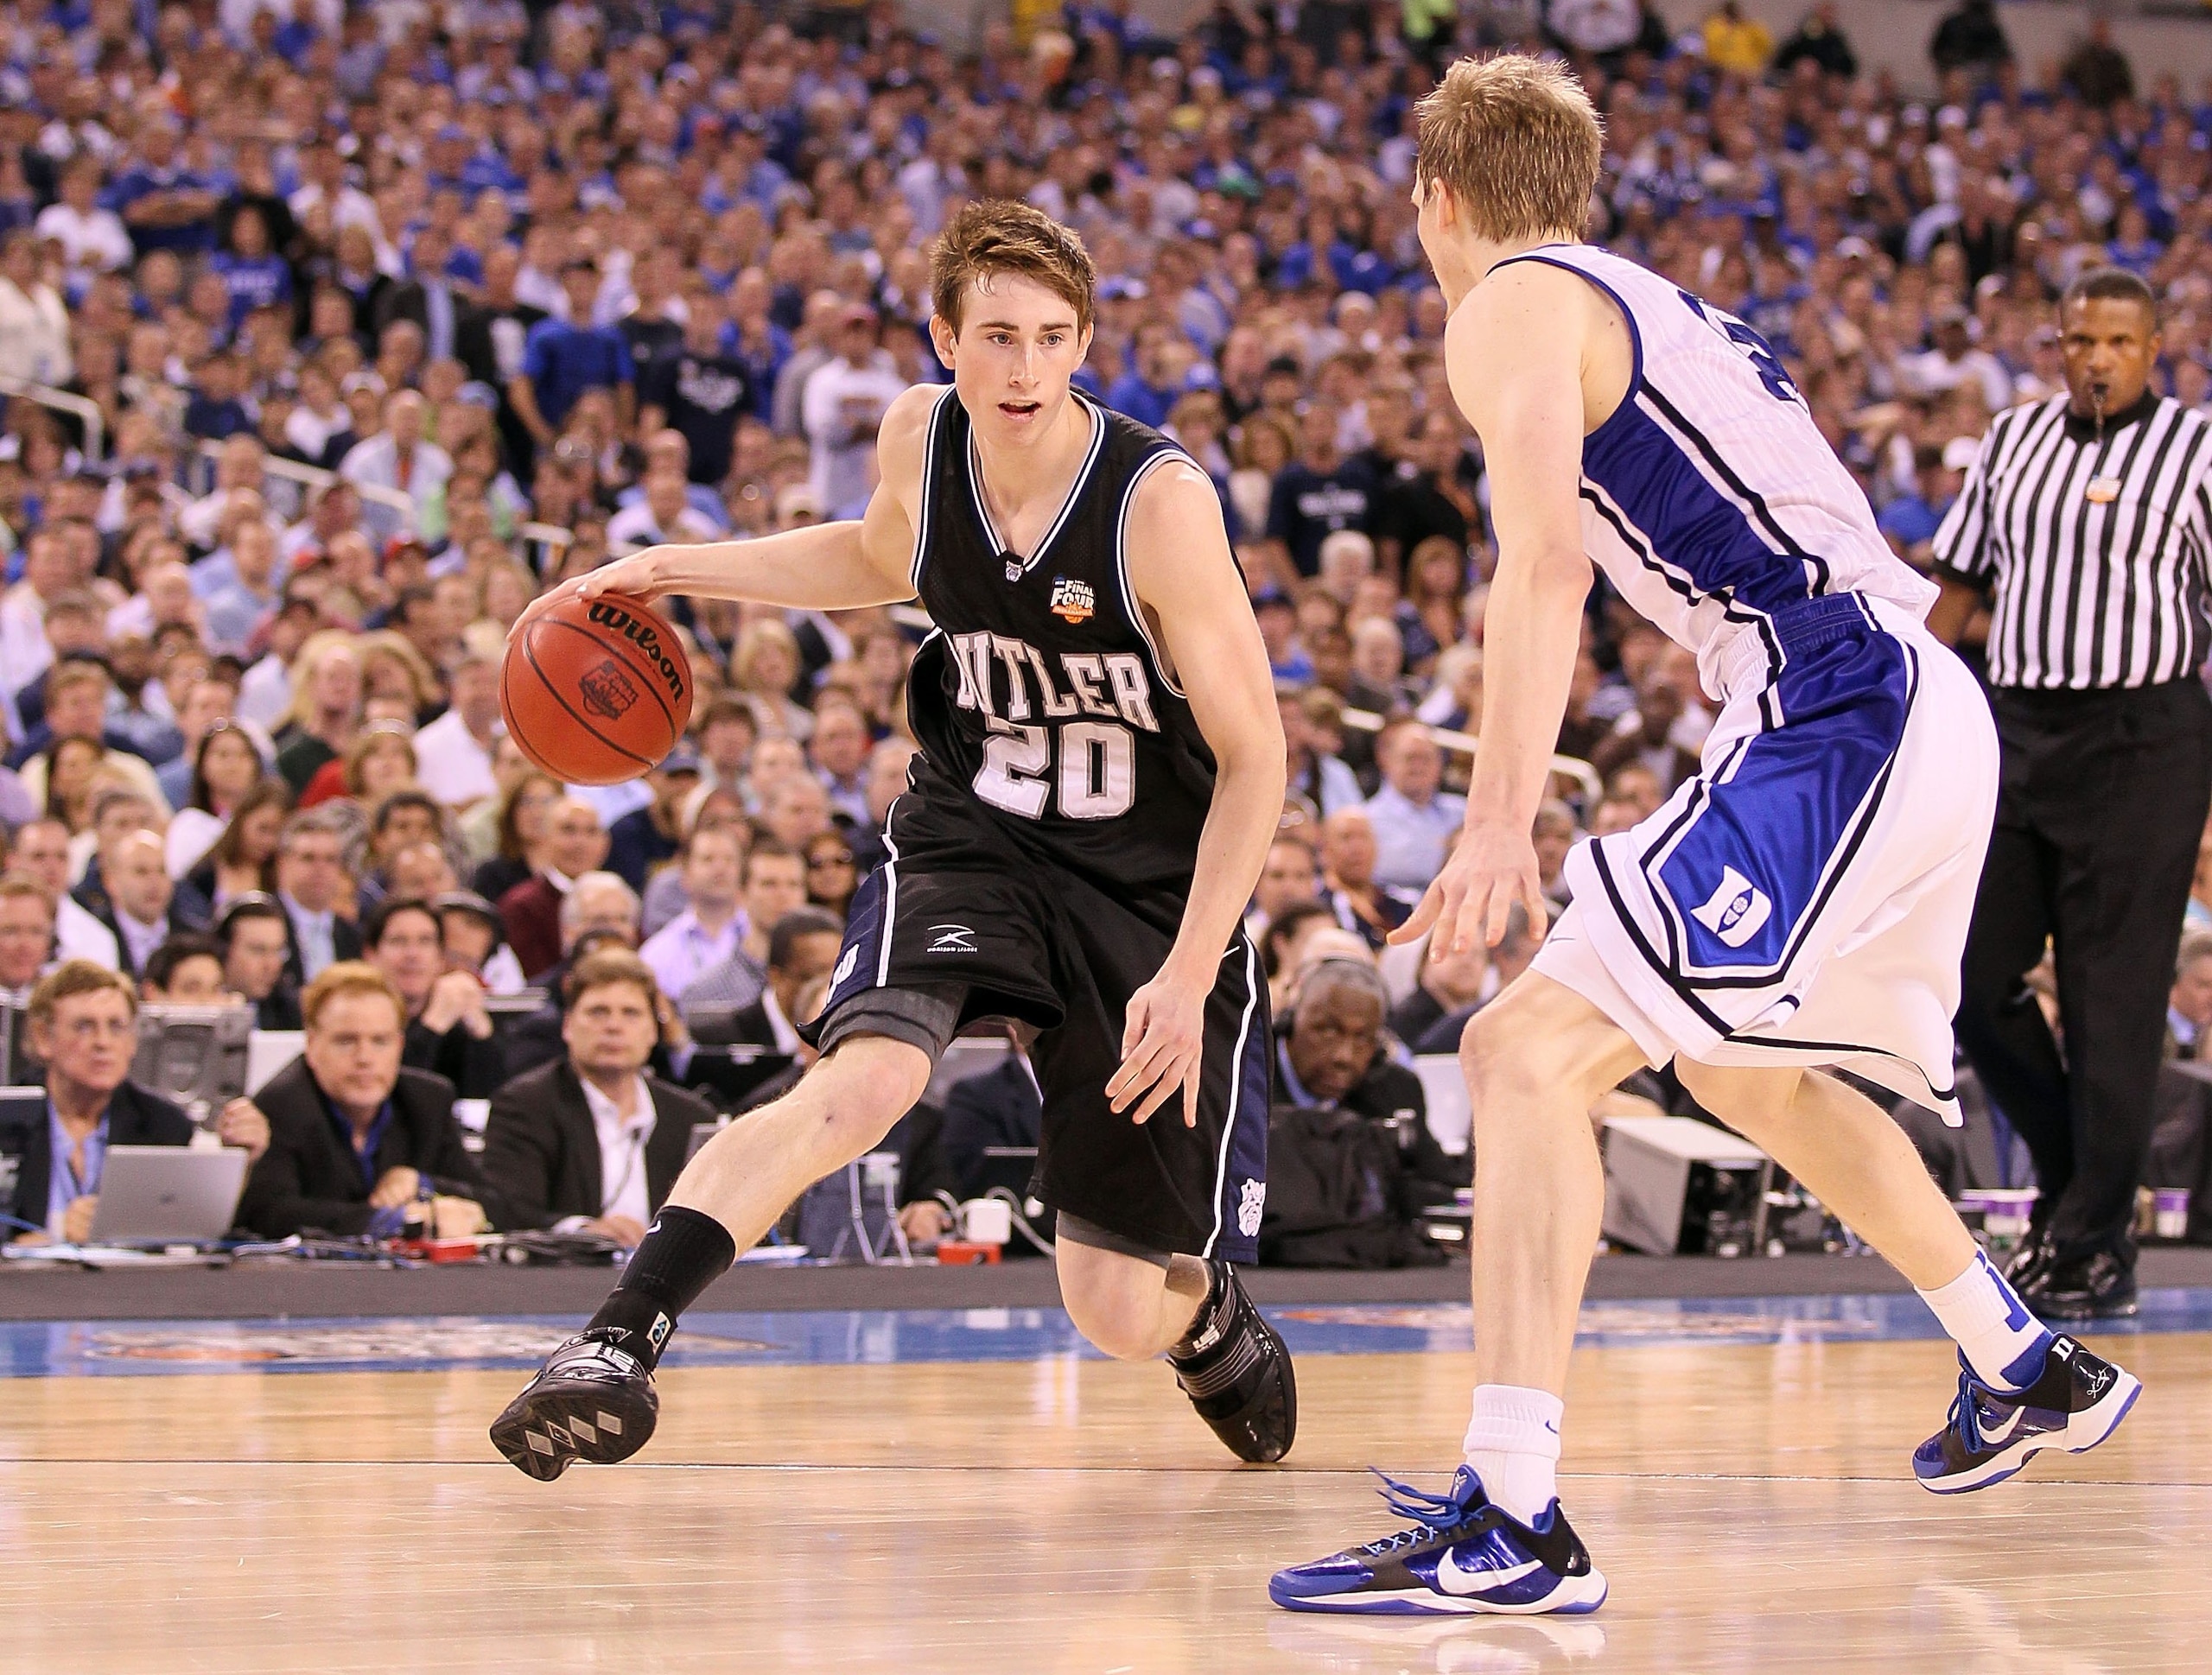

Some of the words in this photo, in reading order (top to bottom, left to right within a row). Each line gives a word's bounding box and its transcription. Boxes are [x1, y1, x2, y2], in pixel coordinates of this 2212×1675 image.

[1050, 587, 1095, 610] FOUR
[1065, 580, 1094, 598] FINAL
[588, 602, 684, 702] Wilson
[953, 630, 1160, 733] UTLER
[972, 715, 1135, 821] 20
